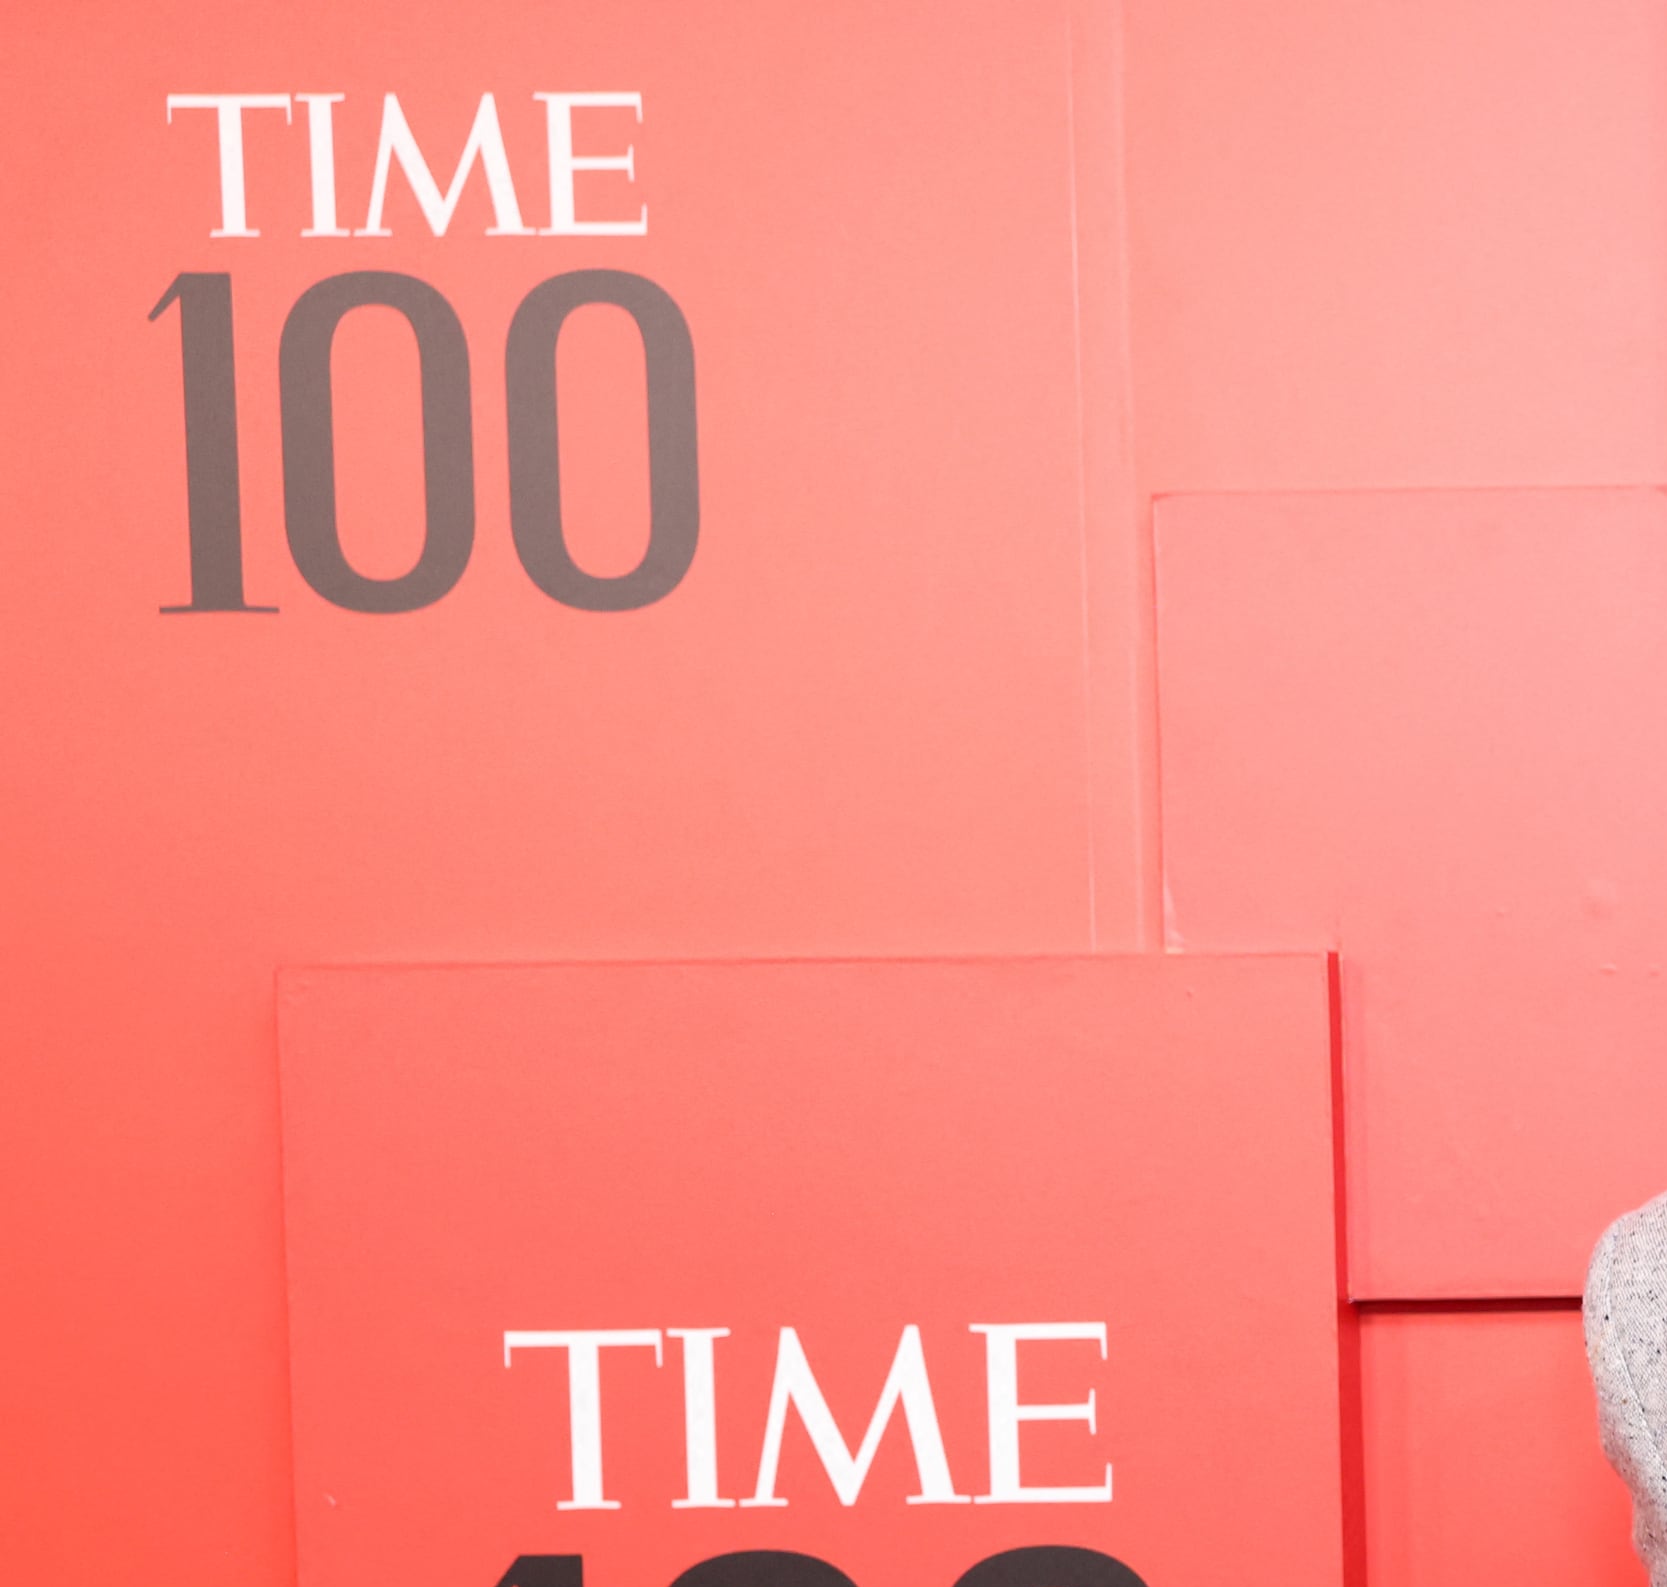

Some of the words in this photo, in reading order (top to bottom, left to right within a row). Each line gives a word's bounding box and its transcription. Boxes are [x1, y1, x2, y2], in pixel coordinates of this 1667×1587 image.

[167, 92, 648, 237] TIME
[148, 269, 700, 615] 100
[503, 1321, 1113, 1510] TIME
